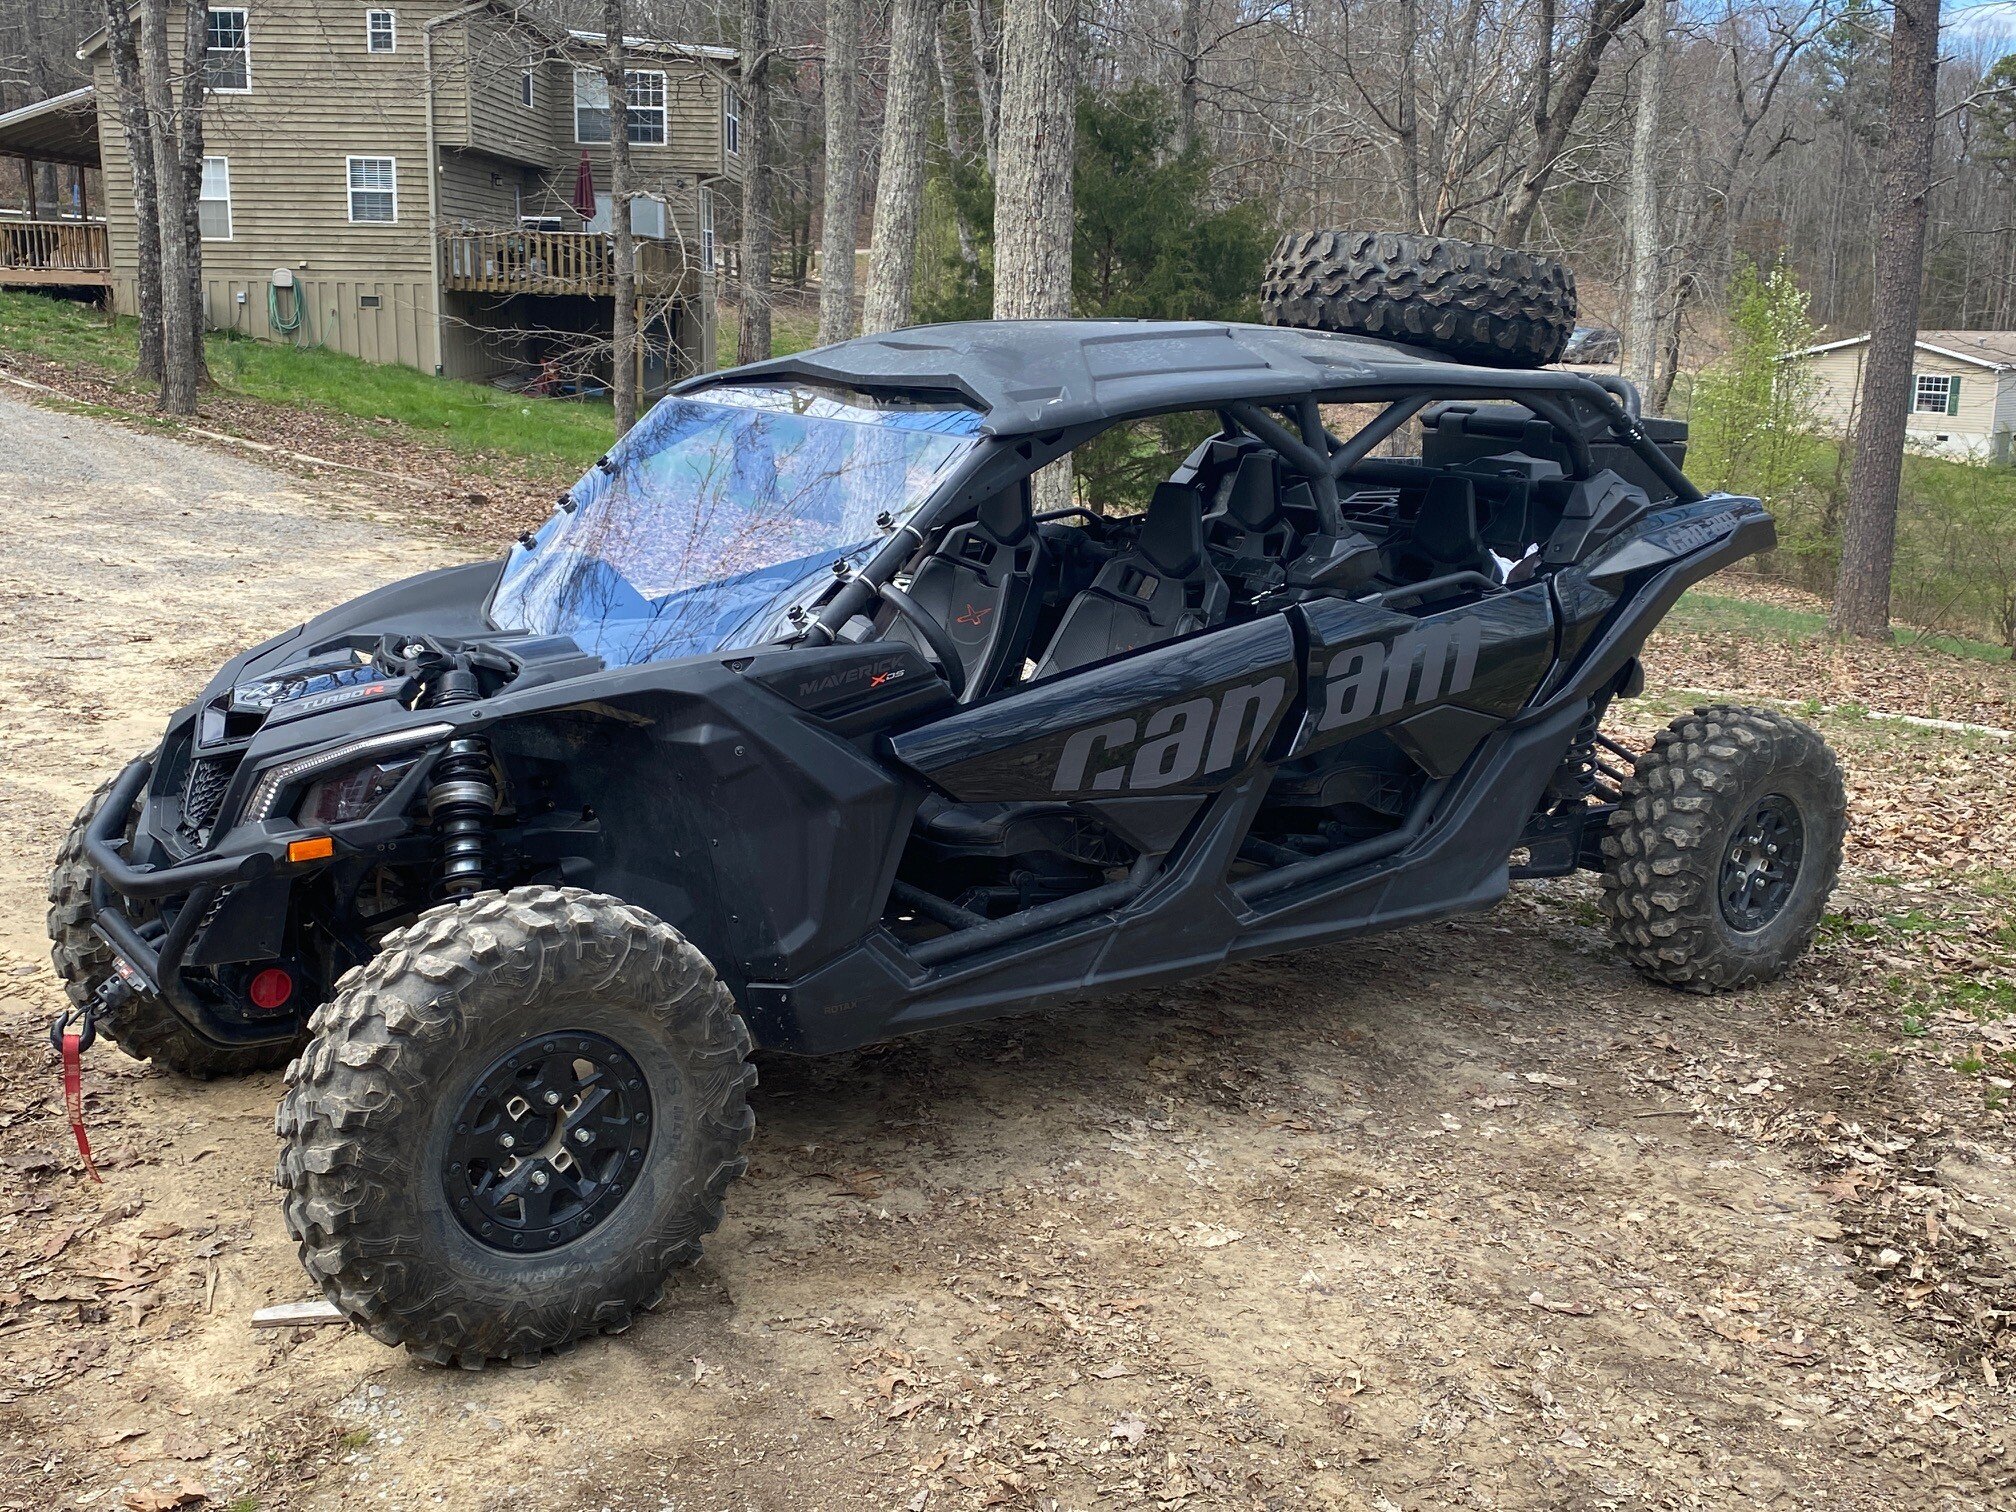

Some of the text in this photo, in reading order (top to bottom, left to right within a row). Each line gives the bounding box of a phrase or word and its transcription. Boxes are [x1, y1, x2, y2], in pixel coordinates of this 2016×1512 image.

[800, 656, 904, 696] MAVERICK
[1051, 615, 1481, 791] can am
[824, 1001, 858, 1015] ROTAX
